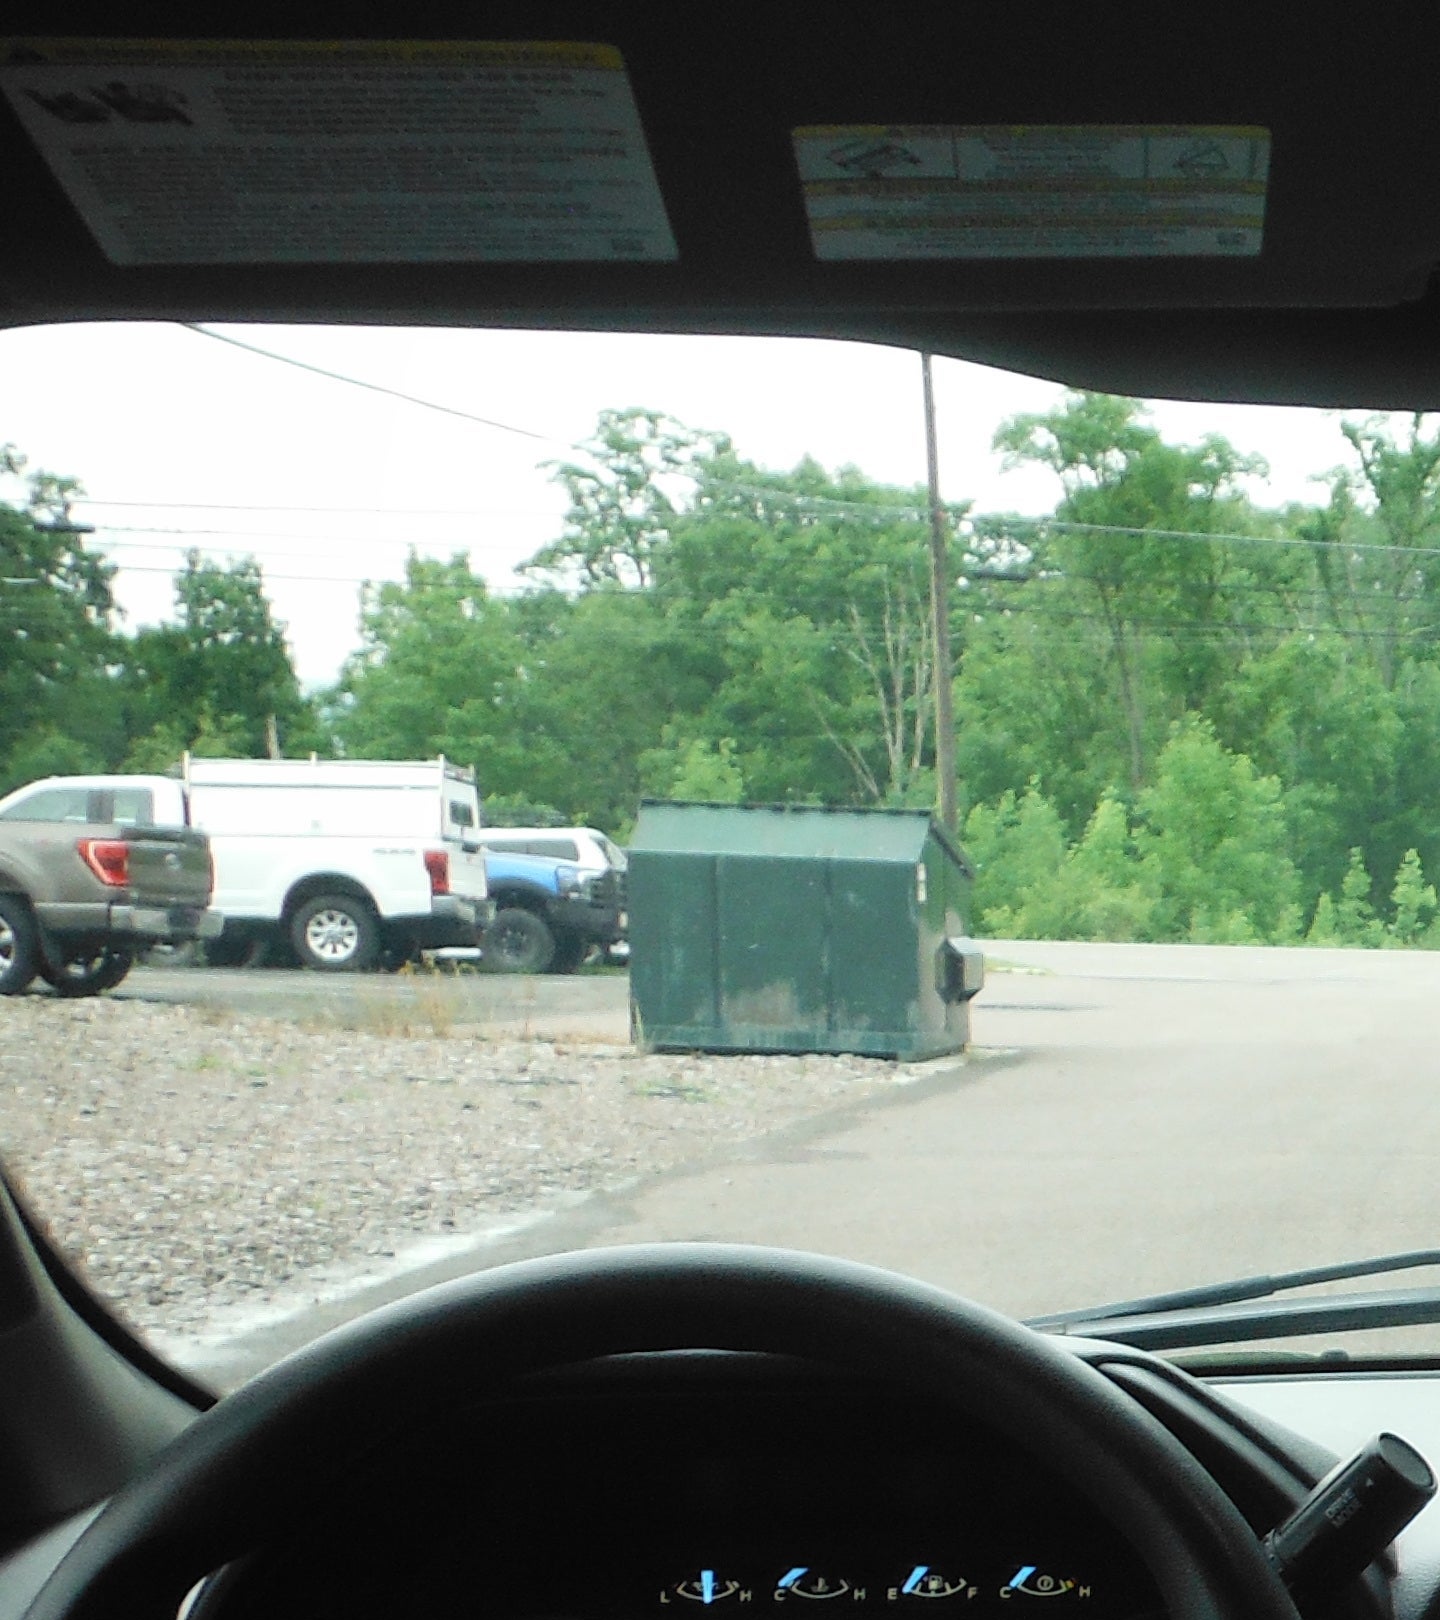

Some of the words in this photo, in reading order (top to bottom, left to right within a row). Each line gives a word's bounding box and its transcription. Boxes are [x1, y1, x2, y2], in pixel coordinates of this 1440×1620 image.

[660, 1590, 670, 1603] L
[739, 1590, 752, 1601] H
[773, 1589, 786, 1601] C
[853, 1588, 866, 1600] H
[887, 1587, 898, 1599] E
[967, 1586, 978, 1599] F
[1000, 1586, 1011, 1598] C
[1079, 1585, 1091, 1598] H
